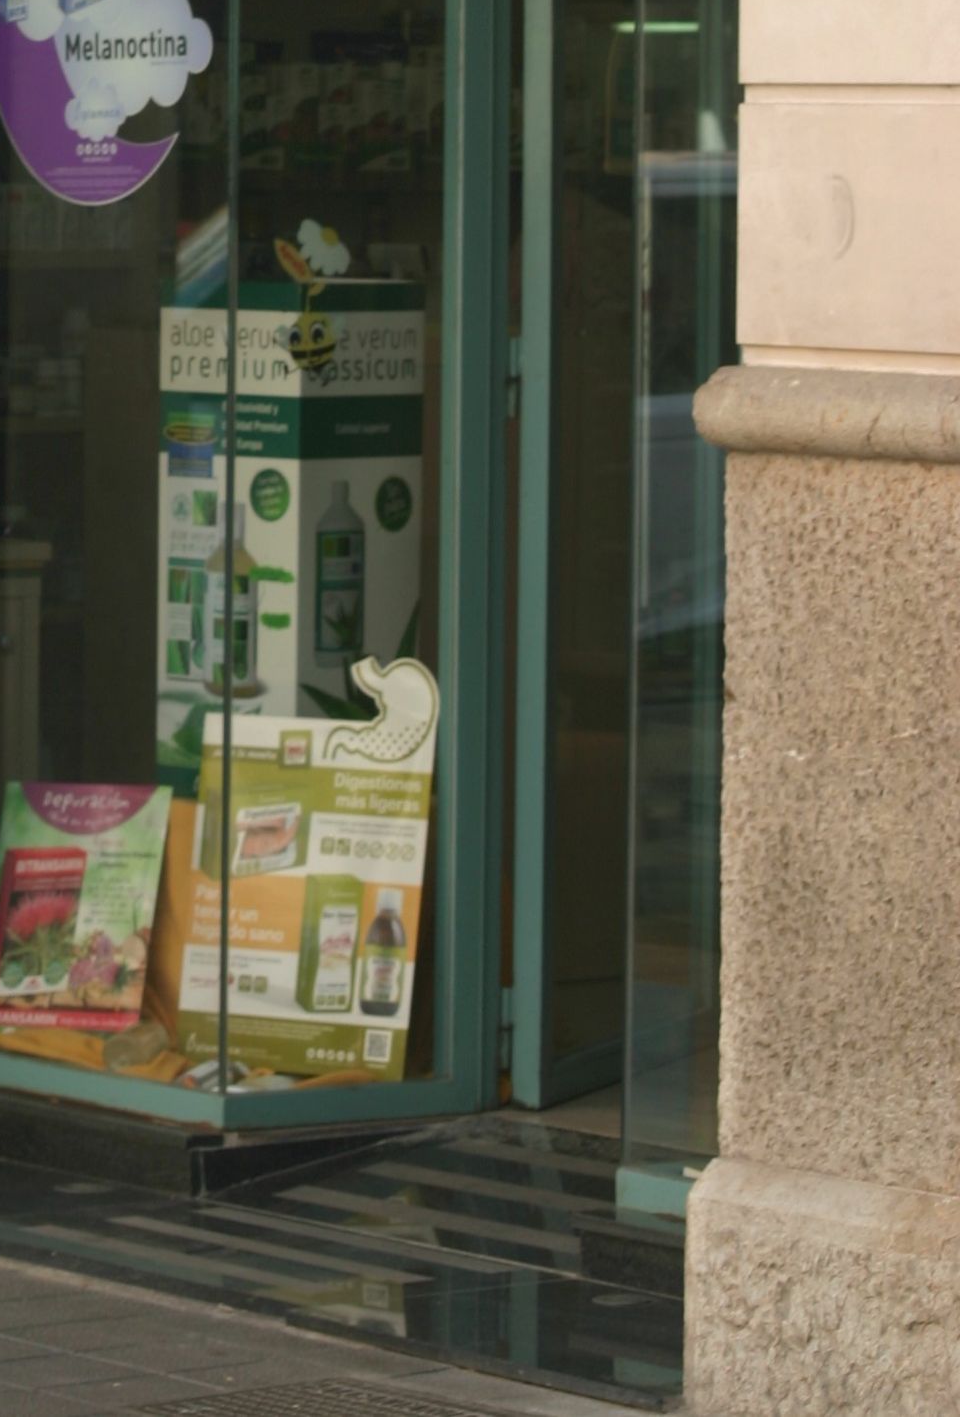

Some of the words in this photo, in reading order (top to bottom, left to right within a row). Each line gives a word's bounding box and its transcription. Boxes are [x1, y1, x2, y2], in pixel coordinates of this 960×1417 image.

[64, 28, 188, 63] Melanoctina
[169, 319, 215, 348] aloe
[356, 327, 417, 350] verum
[334, 772, 423, 793] Digestiones
[335, 795, 368, 809] más
[369, 794, 420, 814] ligeras
